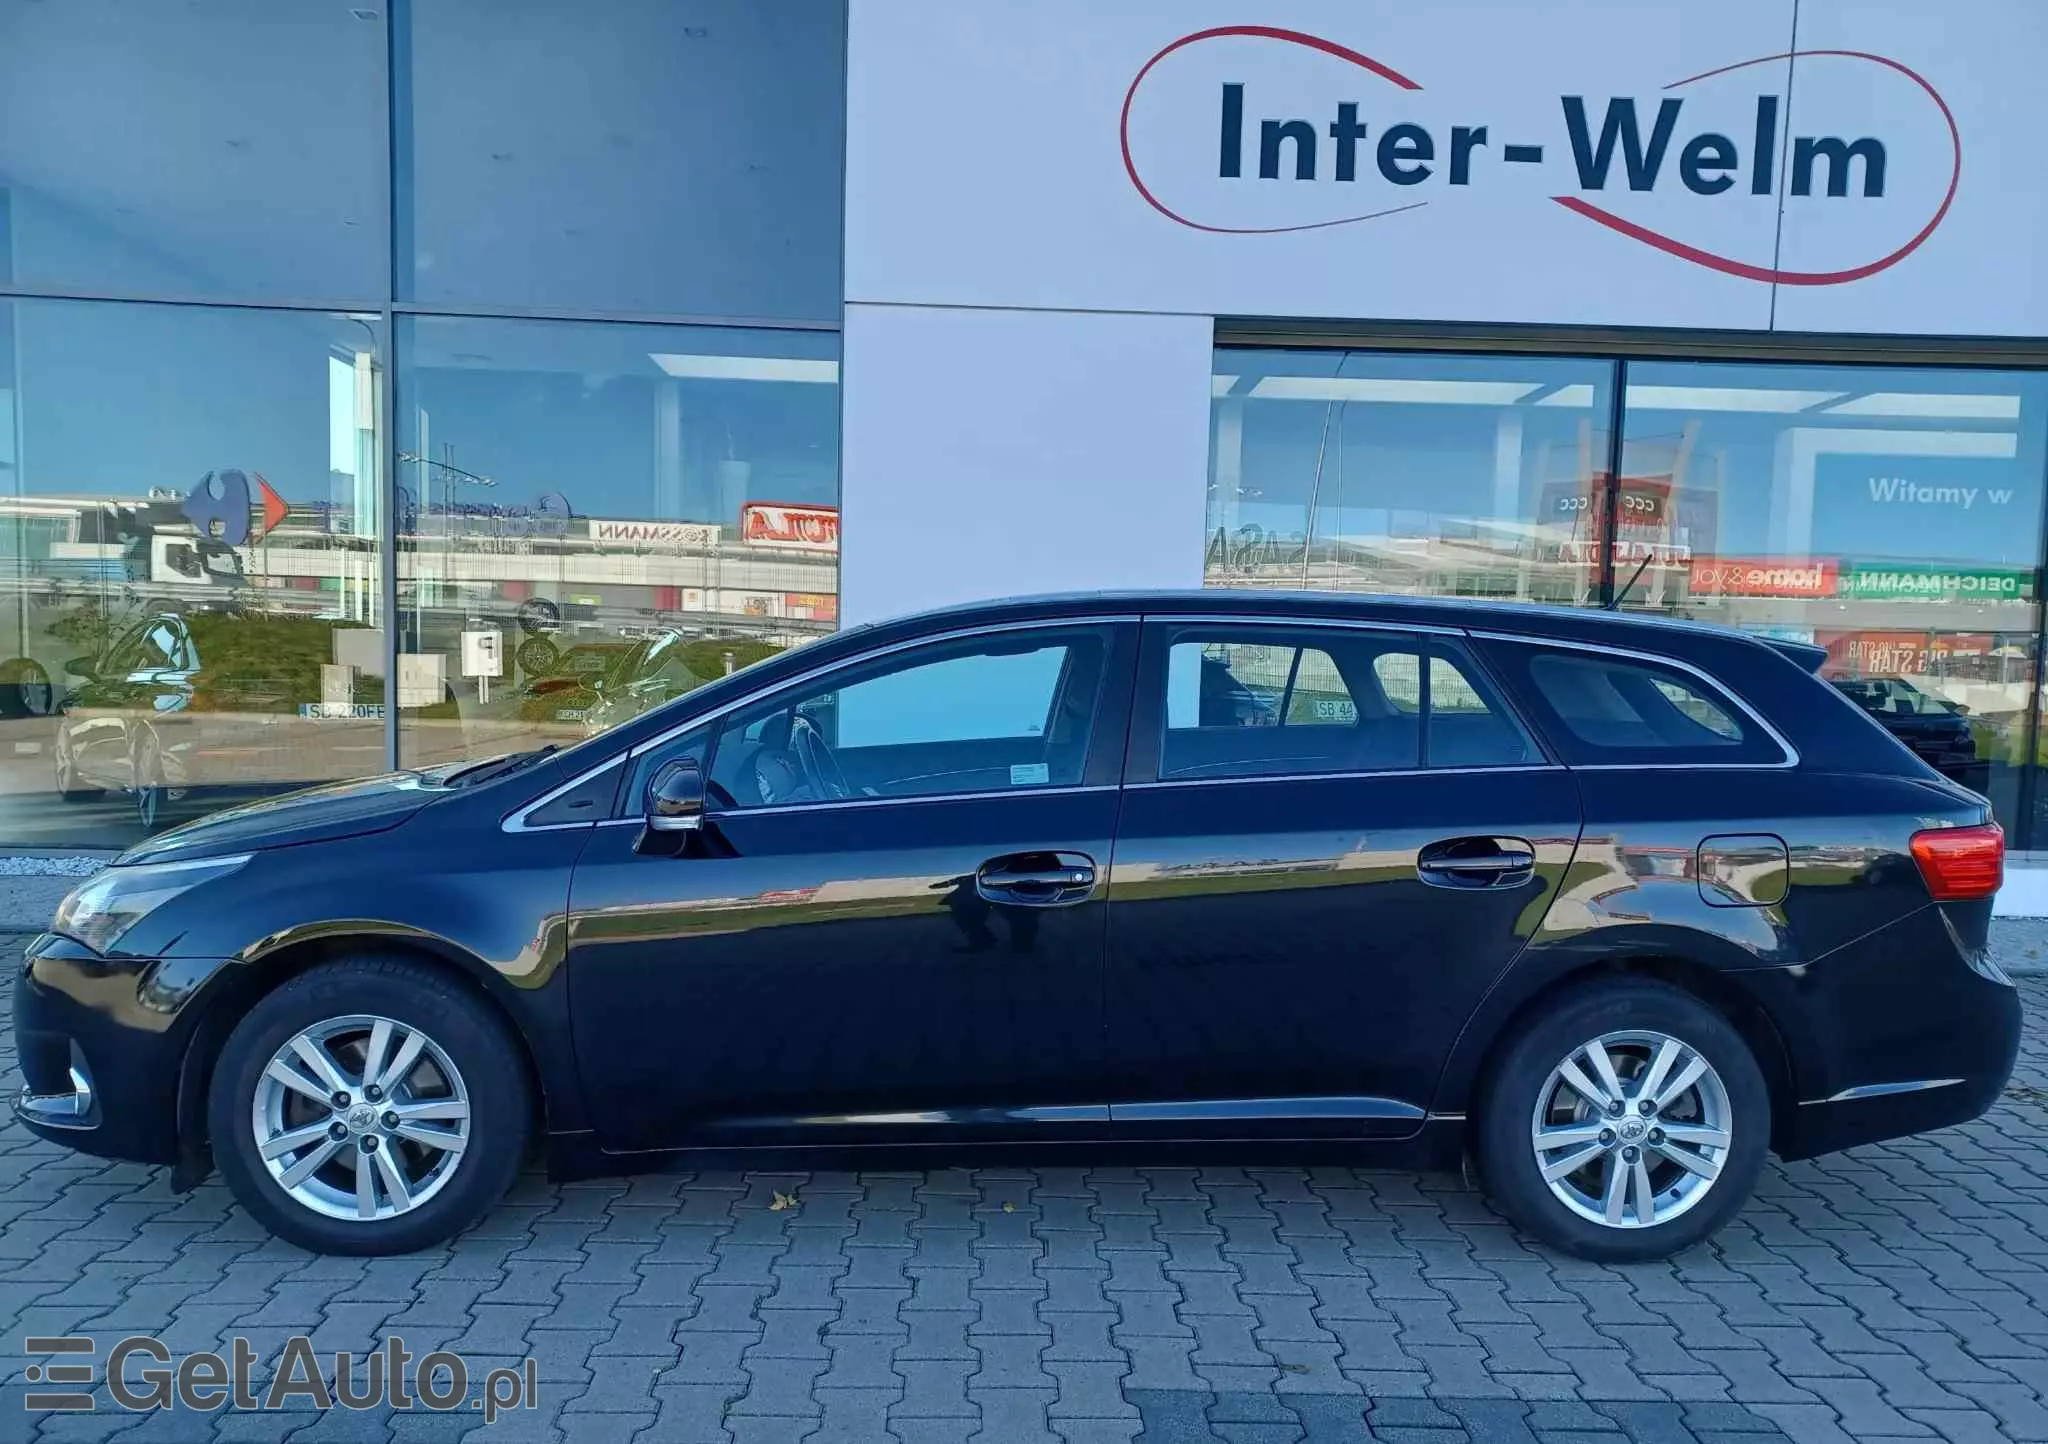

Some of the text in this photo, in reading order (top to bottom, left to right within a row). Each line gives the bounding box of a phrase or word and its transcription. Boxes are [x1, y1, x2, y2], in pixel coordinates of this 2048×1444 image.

[1218, 82, 1887, 198] Inter-Welm
[1868, 478, 2014, 510] Witamy w
